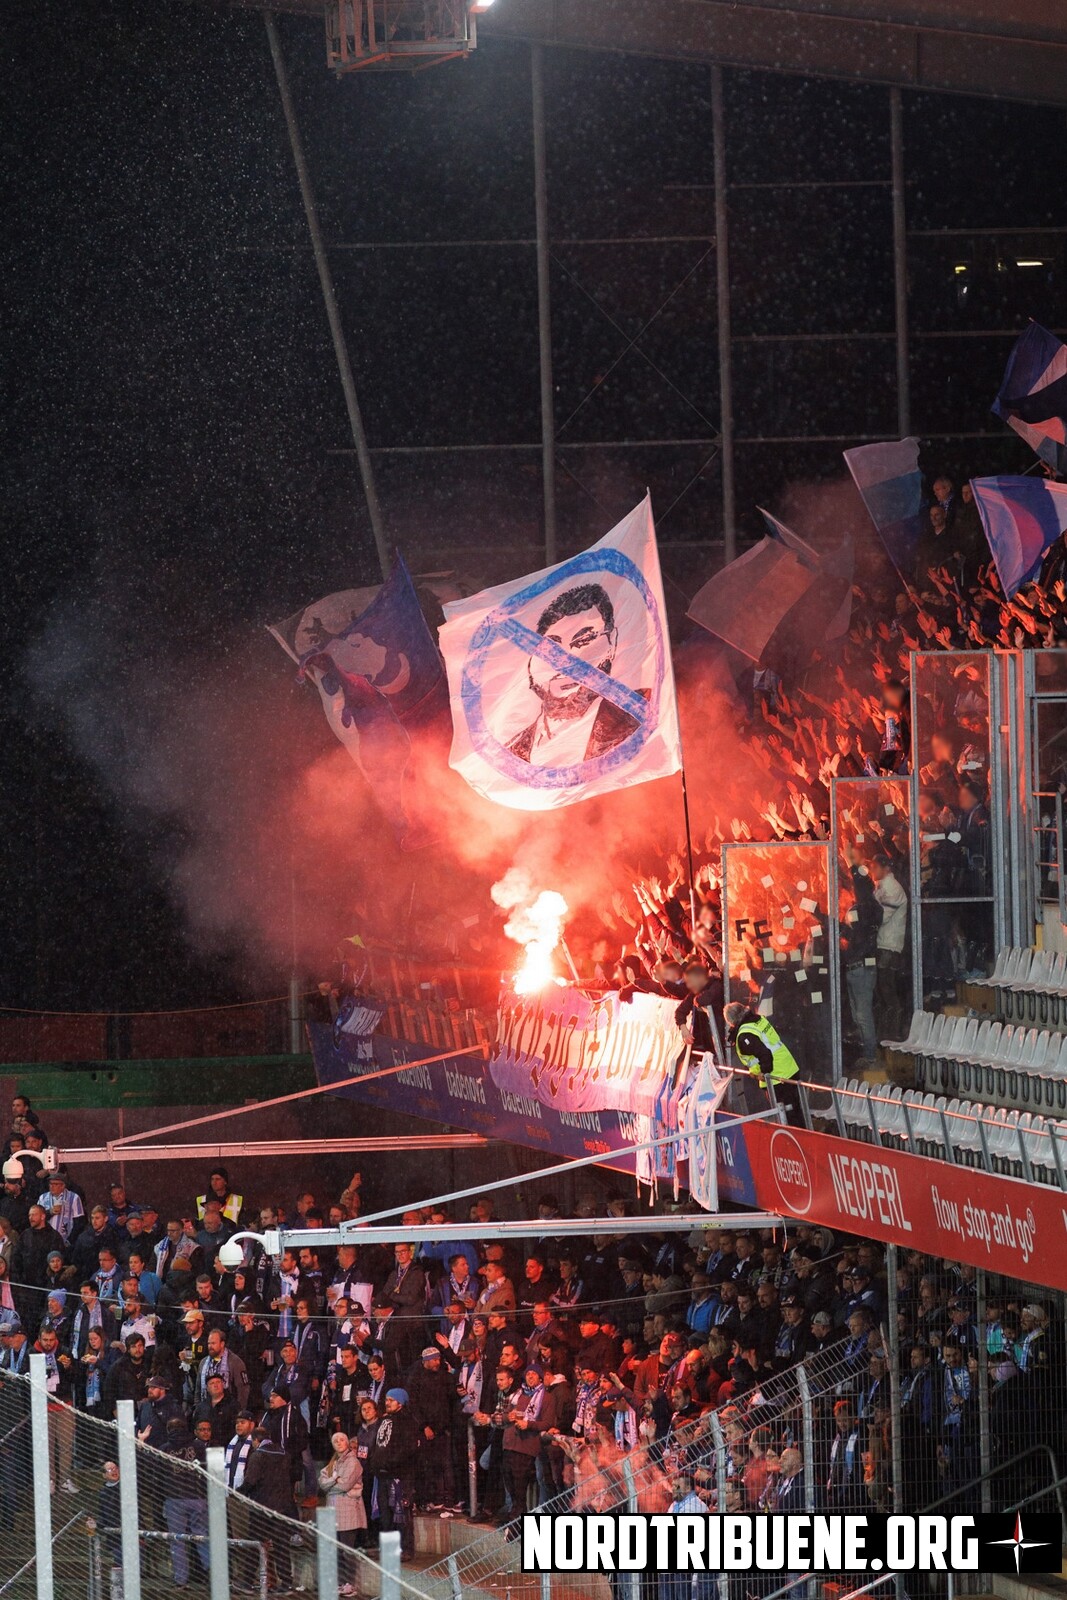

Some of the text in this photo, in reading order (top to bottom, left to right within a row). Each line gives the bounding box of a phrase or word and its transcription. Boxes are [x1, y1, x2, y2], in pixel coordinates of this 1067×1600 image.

[735, 919, 773, 941] FC
[443, 1059, 486, 1104] badenova
[774, 1156, 807, 1188] NEOPERL
[828, 1152, 912, 1231] NEOPERL
[931, 1185, 965, 1242] flow,
[963, 1198, 991, 1253] stop
[990, 1204, 1016, 1249] and
